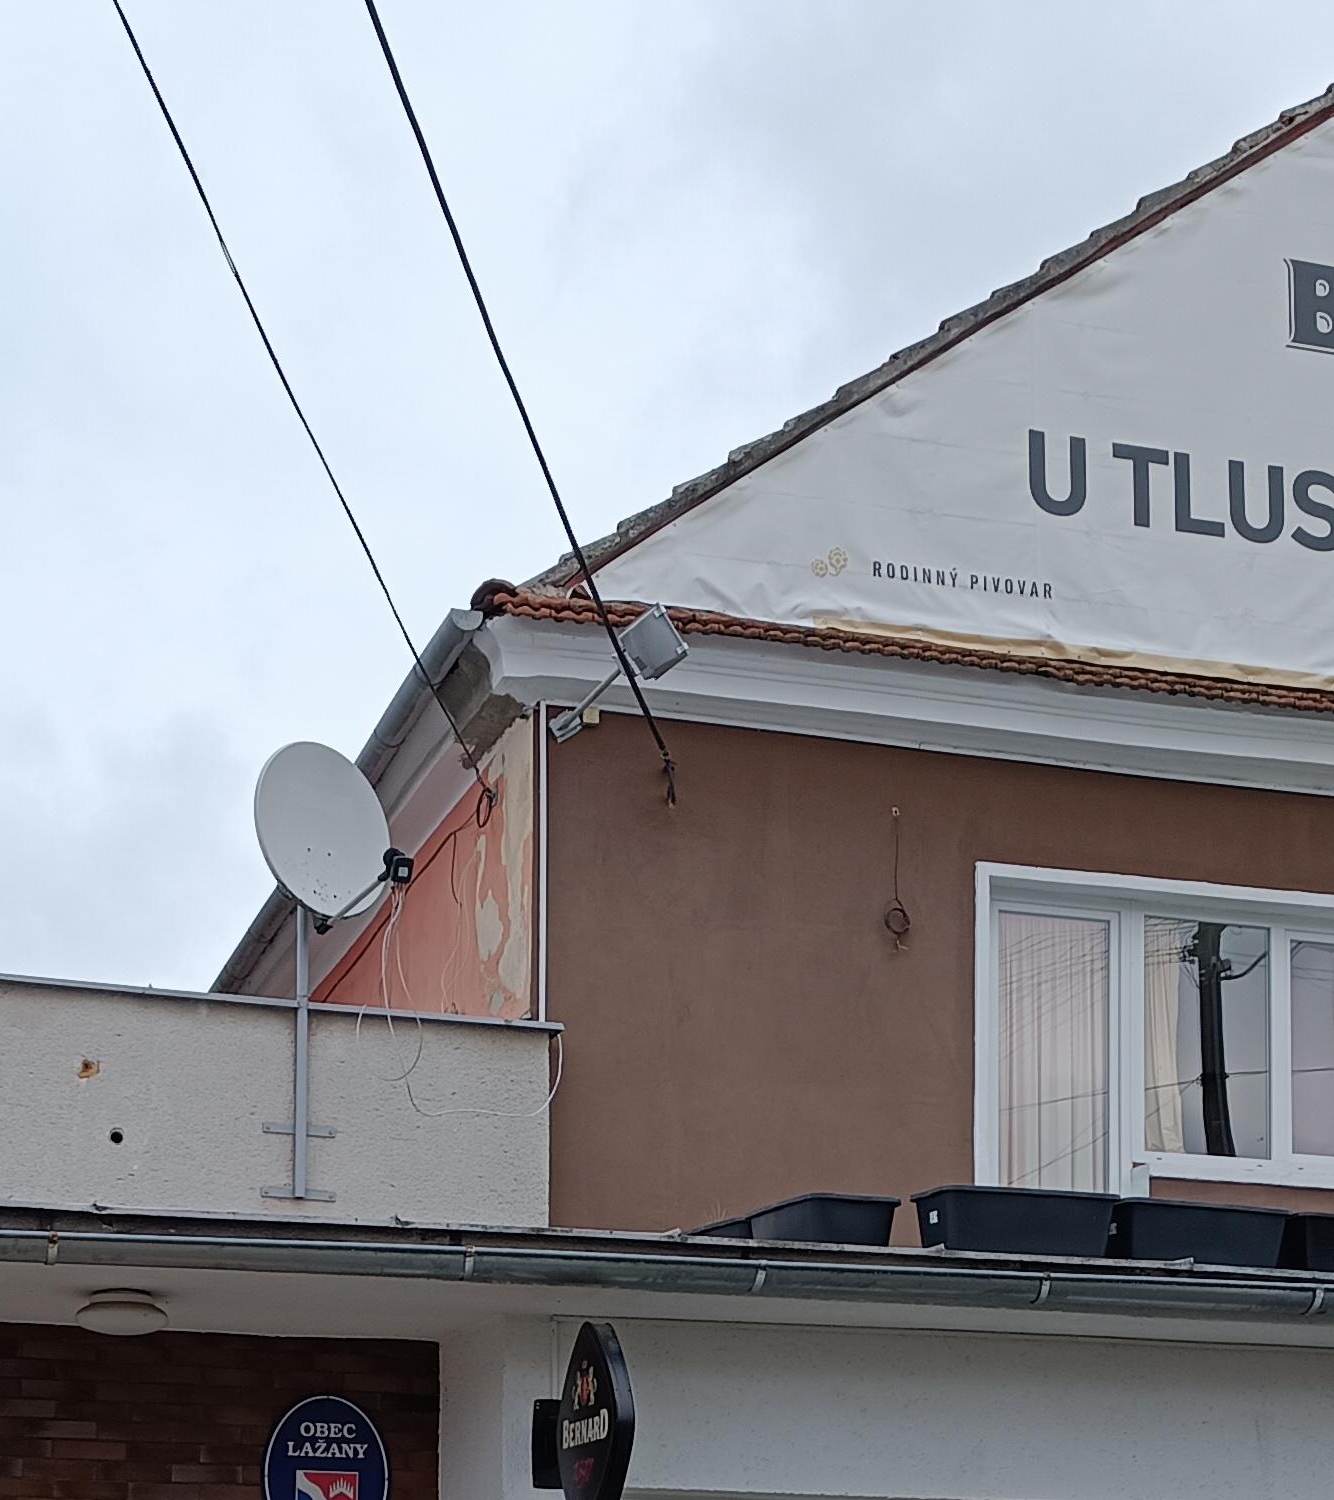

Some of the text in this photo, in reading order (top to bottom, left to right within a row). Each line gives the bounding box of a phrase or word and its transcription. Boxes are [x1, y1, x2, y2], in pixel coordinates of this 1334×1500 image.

[1028, 428, 1087, 517] U
[872, 558, 1054, 600] RODINNÝ PIVOVAR
[286, 1439, 369, 1460] LAŽANY
[299, 1421, 357, 1440] OBEC
[562, 1408, 609, 1450] BERNARD
